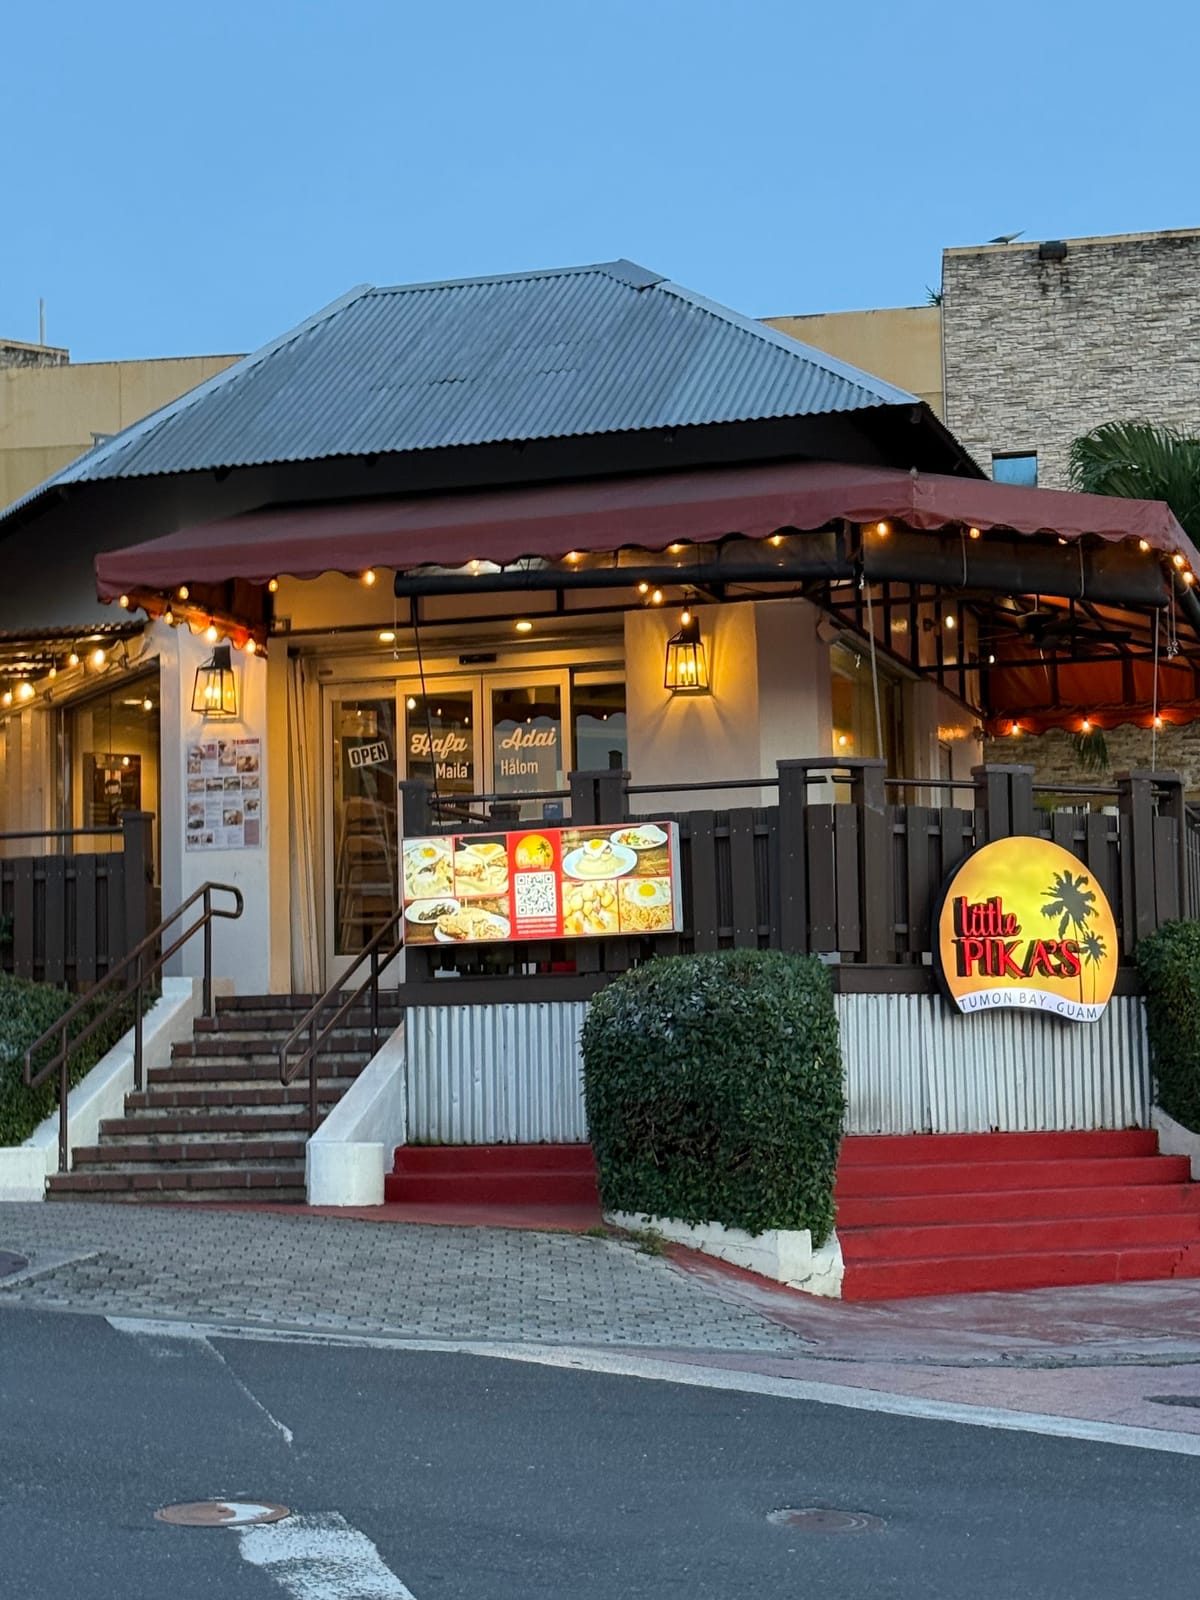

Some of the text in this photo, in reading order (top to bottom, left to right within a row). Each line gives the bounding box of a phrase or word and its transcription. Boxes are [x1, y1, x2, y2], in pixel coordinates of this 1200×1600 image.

[350, 743, 387, 765] OPEN
[411, 727, 557, 759] Hafa Adai
[500, 758, 538, 776] Hålom
[954, 896, 1022, 937] little
[952, 939, 1082, 979] PIKA'S
[959, 992, 1013, 1011] TUMON
[1056, 1001, 1098, 1019] GUAM
